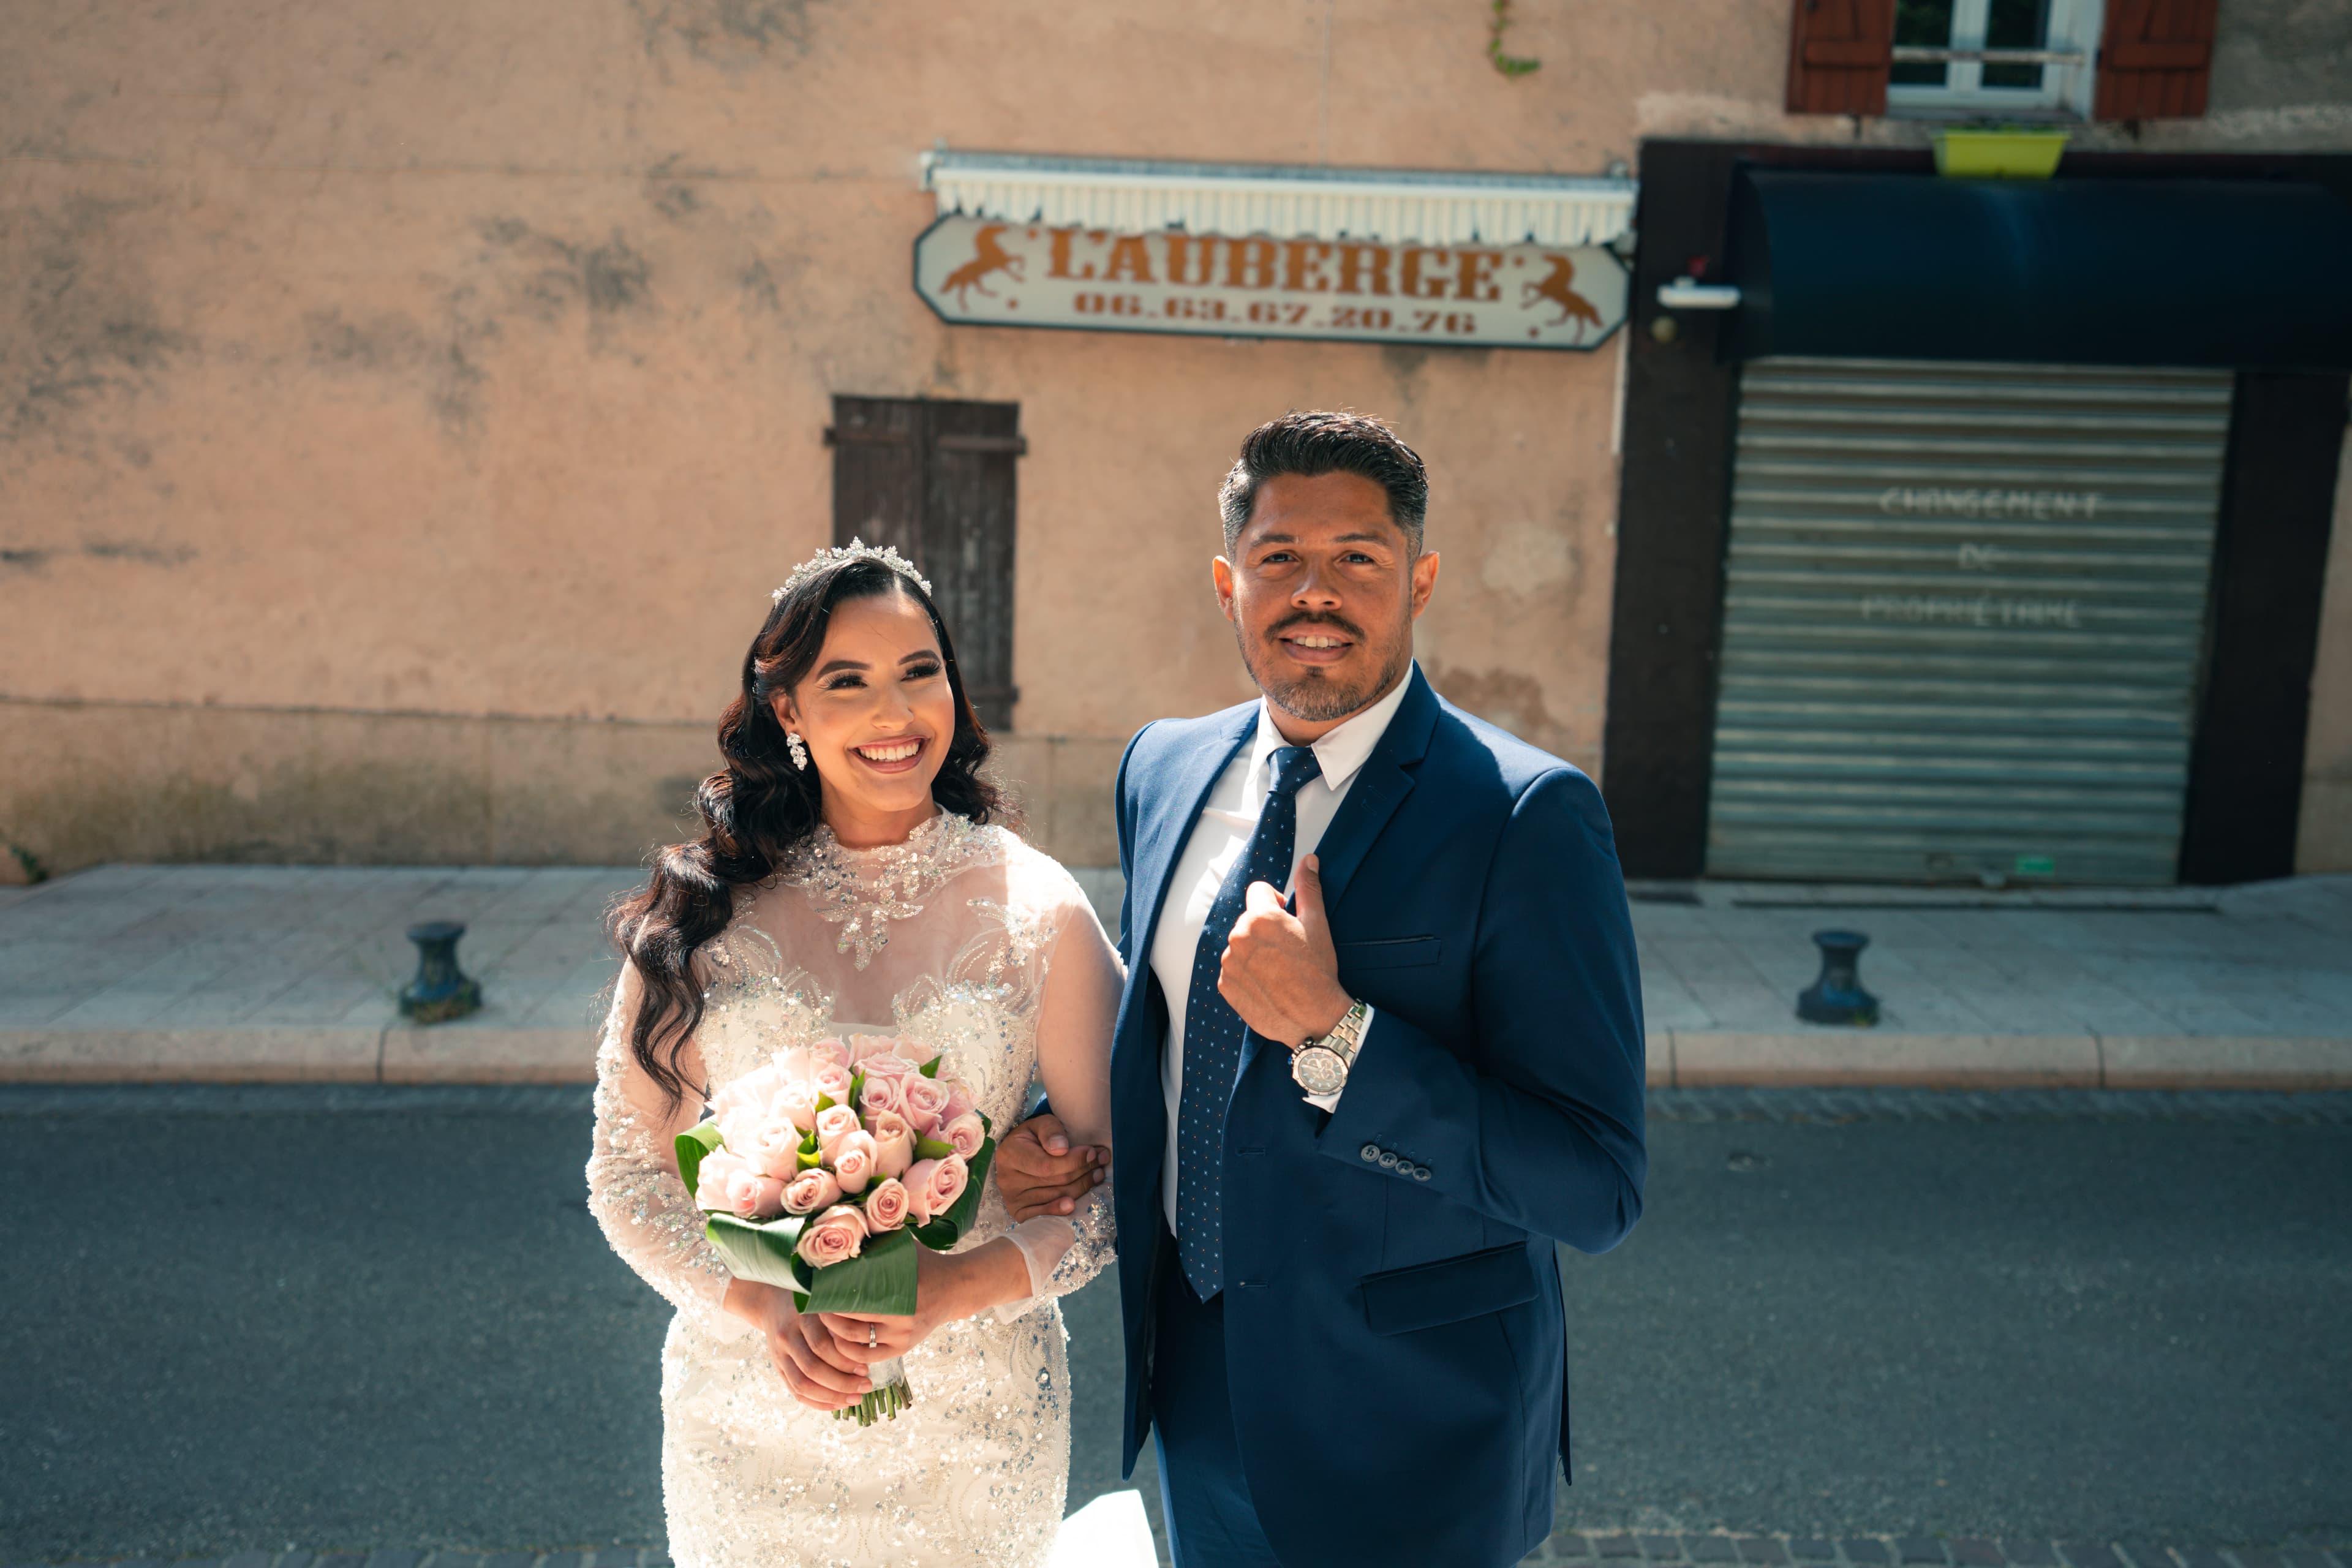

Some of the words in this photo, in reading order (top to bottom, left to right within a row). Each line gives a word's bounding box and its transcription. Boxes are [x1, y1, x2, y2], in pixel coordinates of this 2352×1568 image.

[1047, 228, 1504, 301] L'AUBERGE
[1074, 292, 1476, 335] 06.63.67.20.76
[1878, 487, 2102, 519] CHANGEMENT
